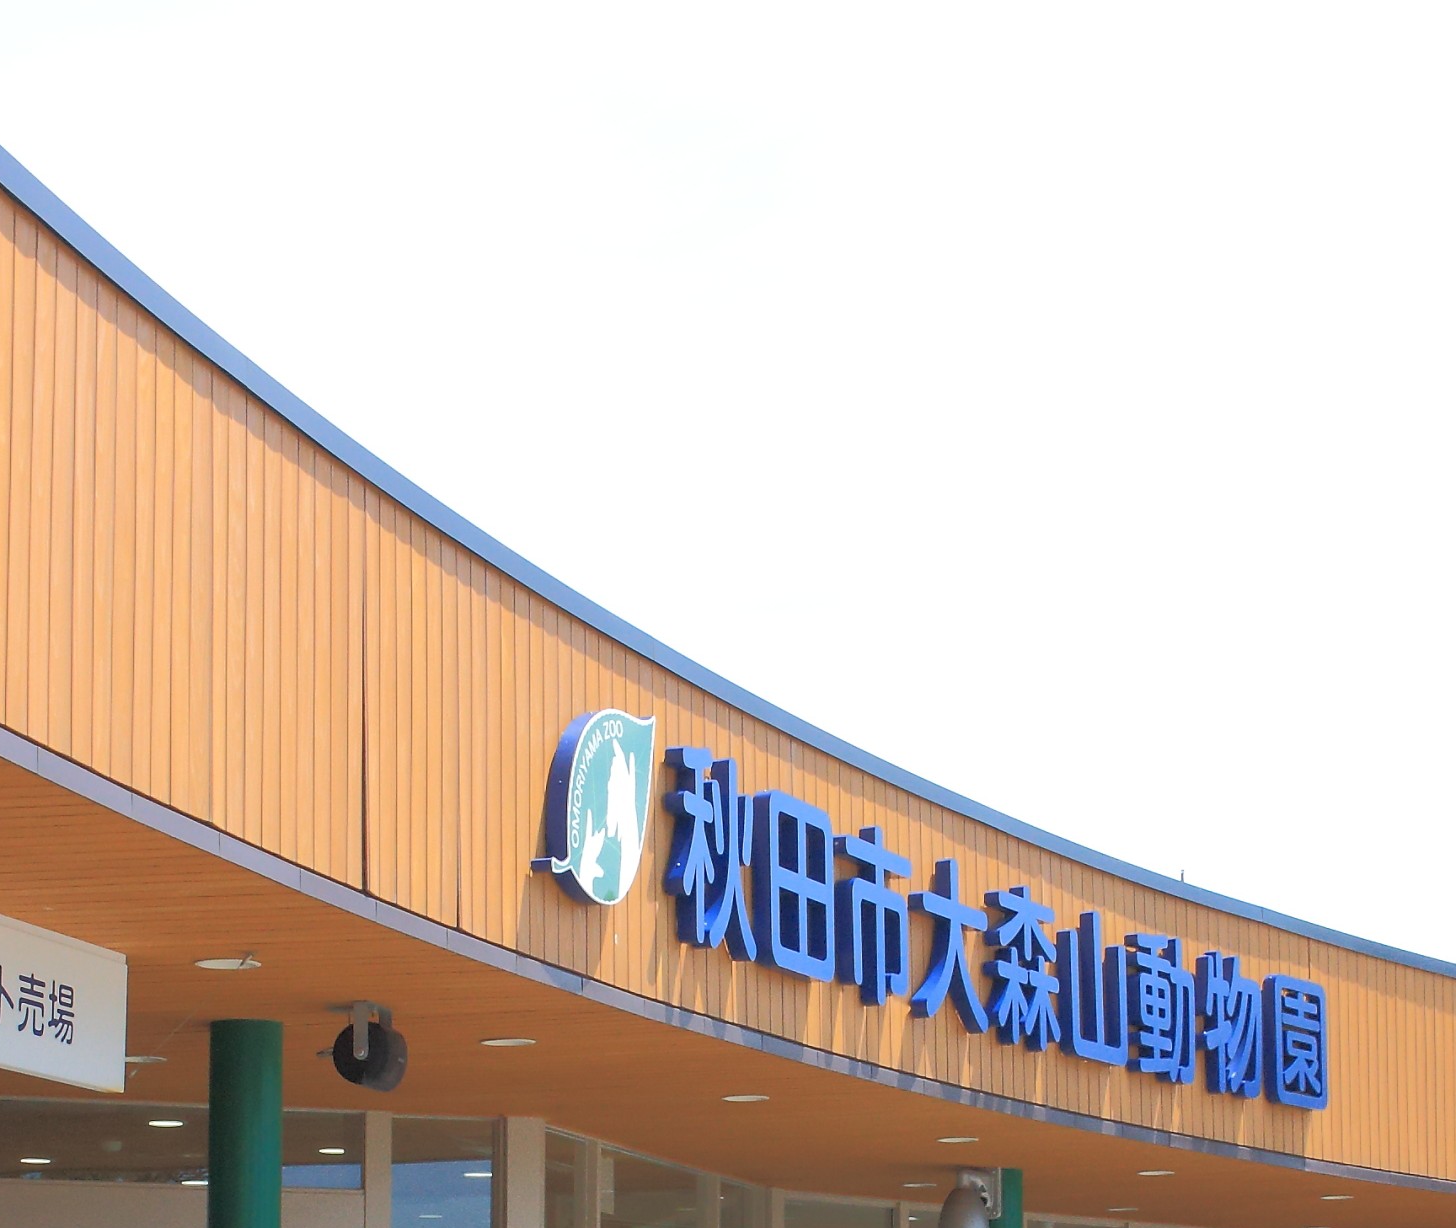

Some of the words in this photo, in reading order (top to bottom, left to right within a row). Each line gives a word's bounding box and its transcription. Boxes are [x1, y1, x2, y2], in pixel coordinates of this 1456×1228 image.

[571, 728, 604, 849] OMORIYAMA
[603, 719, 624, 741] ZOO
[665, 745, 1329, 1112] 秋田市大森山動物園
